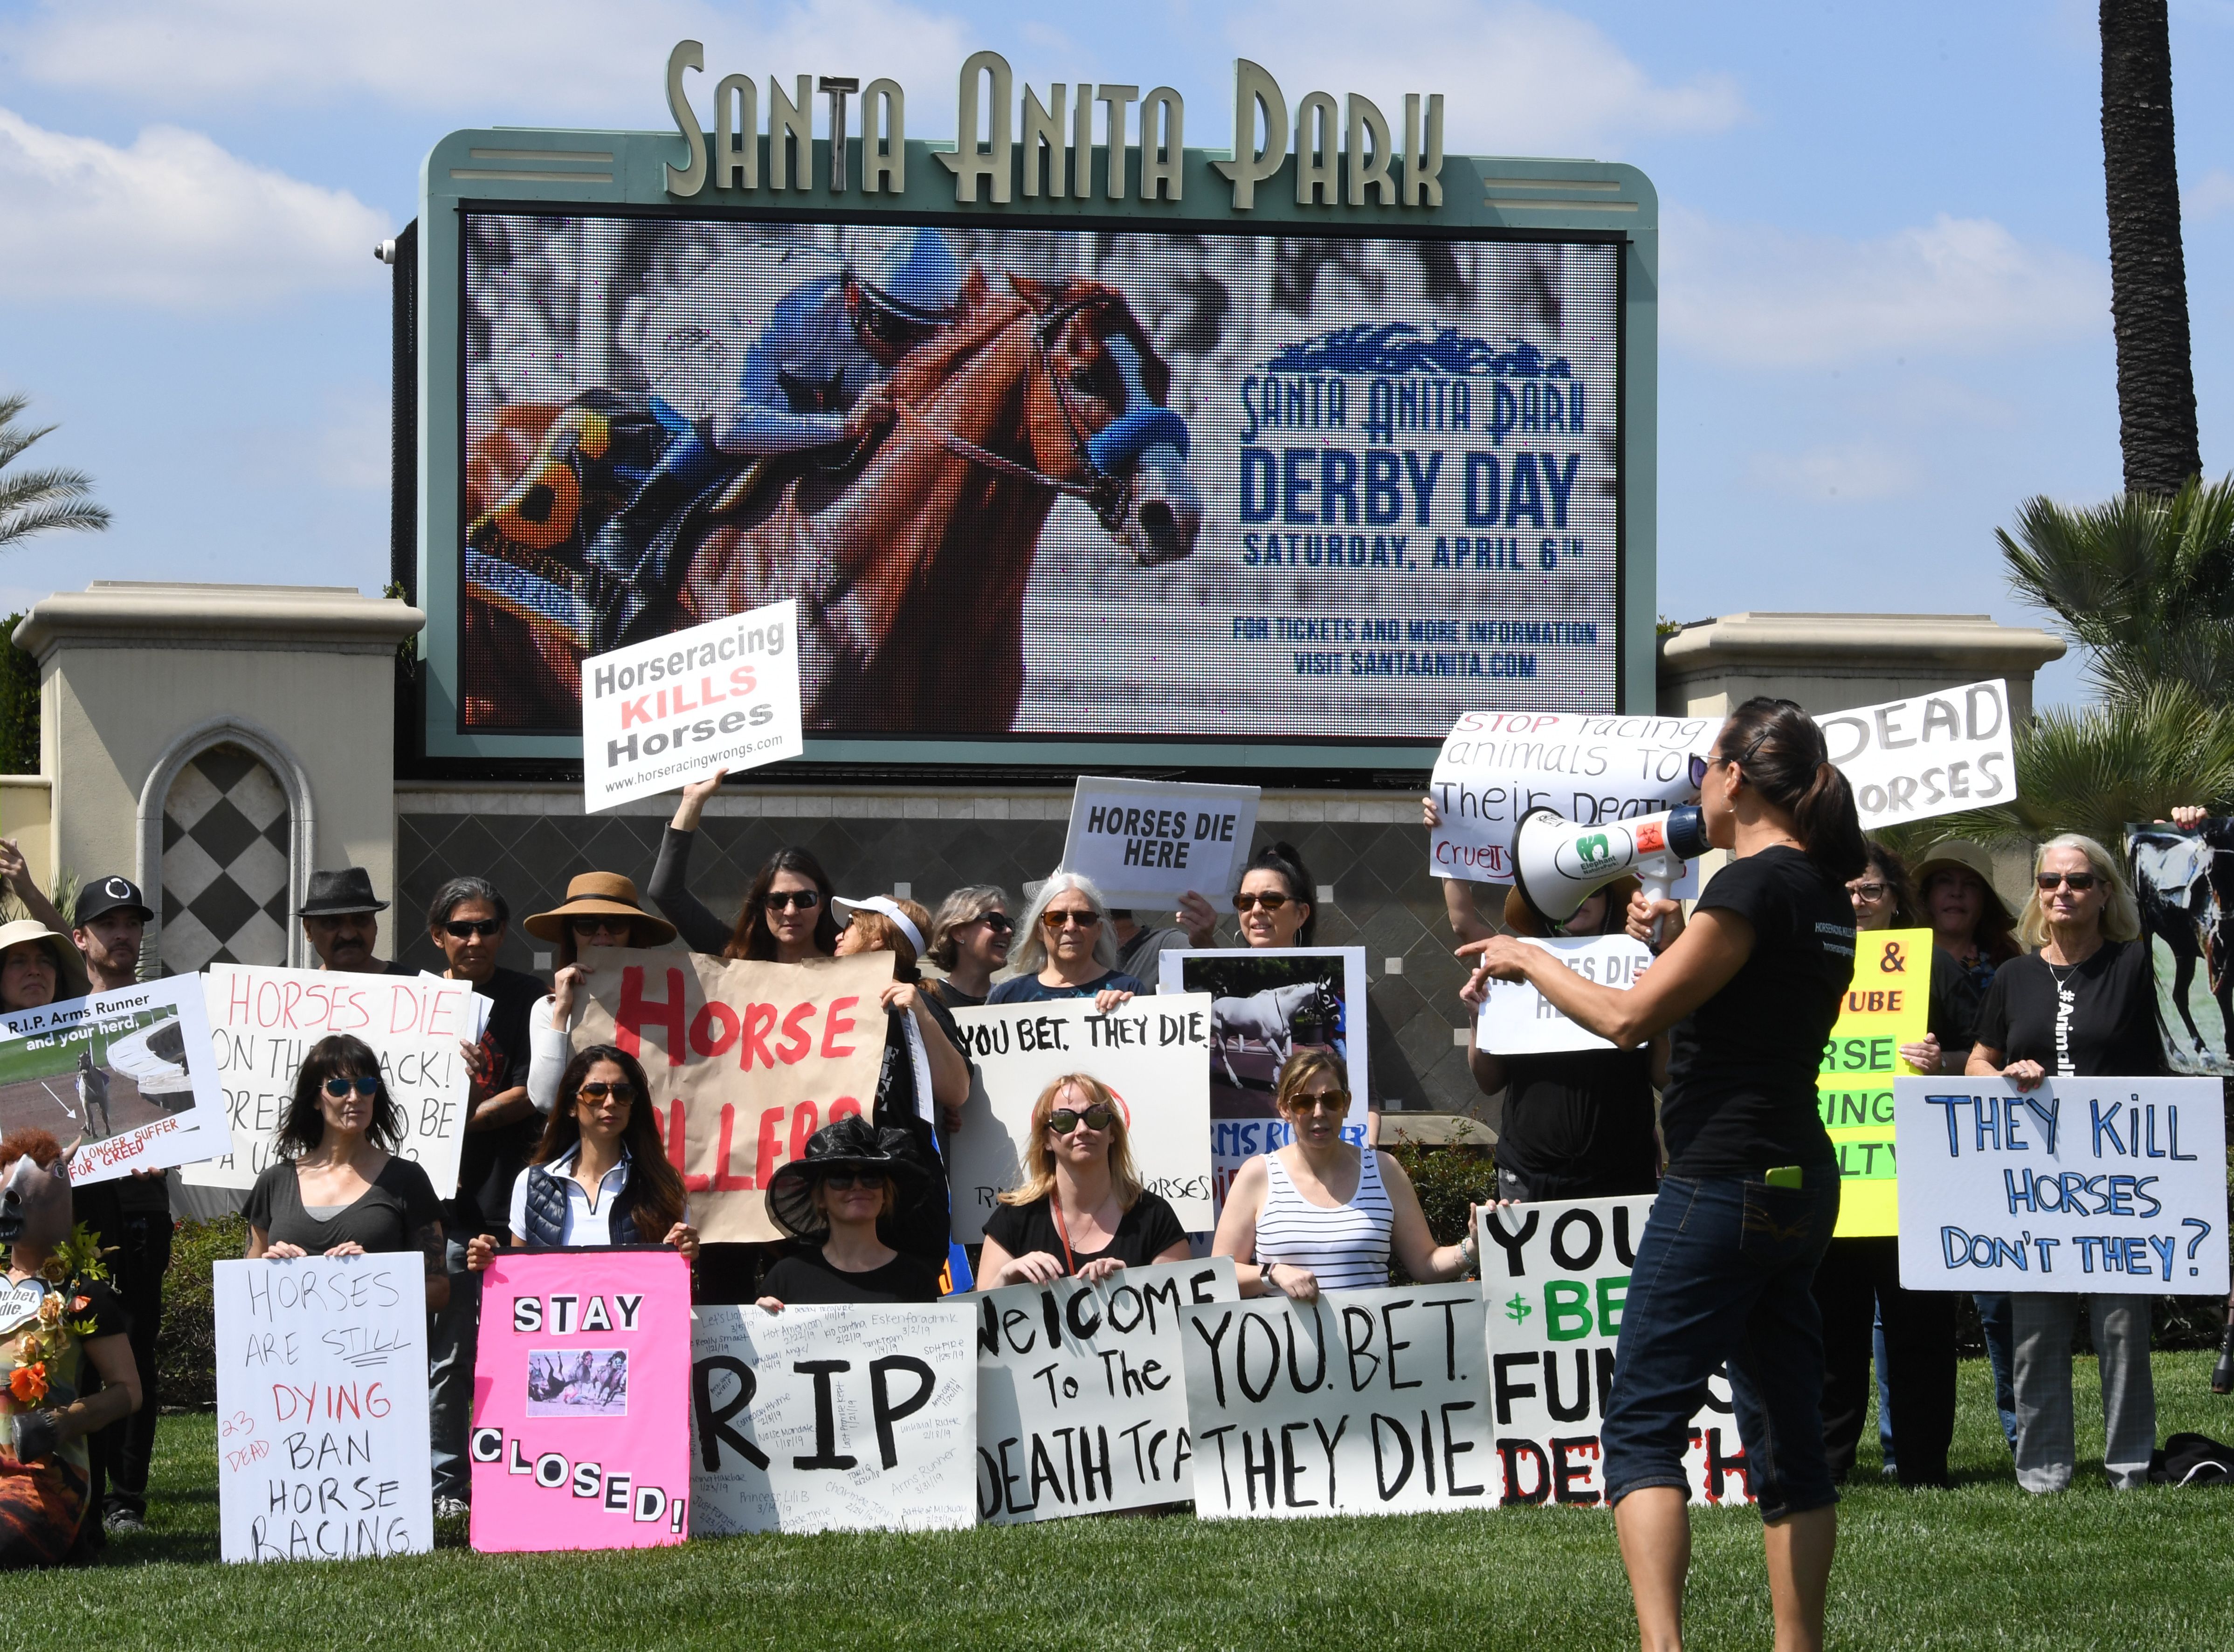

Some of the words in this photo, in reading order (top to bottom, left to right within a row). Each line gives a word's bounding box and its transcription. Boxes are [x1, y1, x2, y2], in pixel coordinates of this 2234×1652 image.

[666, 40, 905, 197] SANTA
[932, 51, 1184, 203] ANITA
[1208, 57, 1444, 210] PARK
[1240, 374, 1347, 444] SANTA
[1361, 375, 1471, 444] ANITA
[1485, 379, 1586, 446] PARK
[1240, 446, 1444, 527] DERBY
[1465, 450, 1581, 529] DAY
[1242, 533, 1417, 571] SATURDAY,
[1431, 537, 1525, 571] APRIL
[1232, 616, 1269, 640] FOR
[1276, 616, 1356, 641] TICKETS
[1360, 618, 1400, 642] AND
[1407, 619, 1459, 643] MORE
[1466, 620, 1598, 645] INFORMATION
[594, 622, 785, 699] Horseracing
[1294, 651, 1344, 675] VISIT
[1350, 650, 1537, 678] SANTAANITA.COM
[621, 665, 758, 730] KILLS
[607, 703, 774, 768] Horses
[1456, 713, 1560, 733] STOP
[1578, 717, 1708, 750] racing
[1820, 683, 2003, 766] DEAD
[605, 735, 783, 793] www.horseracingwrongs.com
[1447, 739, 1608, 776] animals
[1637, 749, 1683, 783] TO
[1434, 780, 1551, 823] Their
[1858, 751, 2004, 816] ORSES
[1087, 805, 1187, 840] HORSES
[1194, 812, 1236, 842] DIE
[1123, 838, 1190, 869] HERE
[1580, 854, 1617, 871] Elephant
[1880, 942, 1906, 974] &
[7, 1015, 46, 1034] R.I.P.
[50, 1008, 92, 1026] Arms
[95, 994, 151, 1015] Runner
[228, 973, 370, 1031] HORSES
[614, 965, 861, 1074] HORSE
[1848, 989, 1904, 1013] UBE
[26, 1034, 55, 1052] and
[59, 1026, 96, 1048] your
[957, 1019, 1010, 1058] YOU
[1016, 1015, 1070, 1052] BET.
[1083, 1013, 1148, 1049] THEY
[1157, 1010, 1209, 1049] DIE.
[210, 1027, 255, 1071] ON
[268, 1038, 309, 1082] TH
[379, 1049, 452, 1088] ACK!
[419, 1098, 457, 1138] BE
[1924, 1094, 2060, 1158] THEY
[68, 1160, 97, 1183] FOR
[102, 1138, 145, 1167] GREED
[81, 1135, 128, 1163] LONGER
[134, 1118, 179, 1144] SUFFER
[1140, 1170, 1211, 1201] ORSES
[2003, 1167, 2162, 1218] HORSES
[1940, 1225, 2061, 1273] DON'T
[2072, 1217, 2212, 1282] THEY?
[247, 1269, 400, 1323] HORSES
[514, 1295, 644, 1332] STAY
[245, 1330, 299, 1368] ARE
[321, 1327, 412, 1356] STILL
[762, 1328, 779, 1341] Hot
[836, 1332, 862, 1345] 2/2/19
[902, 1324, 931, 1337] 3/2/19
[935, 1350, 964, 1363] 1/25/19
[1033, 1362, 1079, 1409] To
[1098, 1349, 1172, 1399] The
[221, 1410, 255, 1437] 23
[272, 1380, 391, 1425] DYING
[692, 1354, 937, 1473] RIP
[225, 1439, 270, 1474] DEAD
[283, 1431, 371, 1471] BAN
[891, 1473, 919, 1496] Arms
[918, 1447, 957, 1478] Runner
[977, 1423, 1114, 1520] DEATH
[269, 1475, 400, 1518] HORSE
[471, 1427, 686, 1535] CLOSED!
[915, 1472, 945, 1495] 3/31/19
[251, 1514, 411, 1563] RACING
